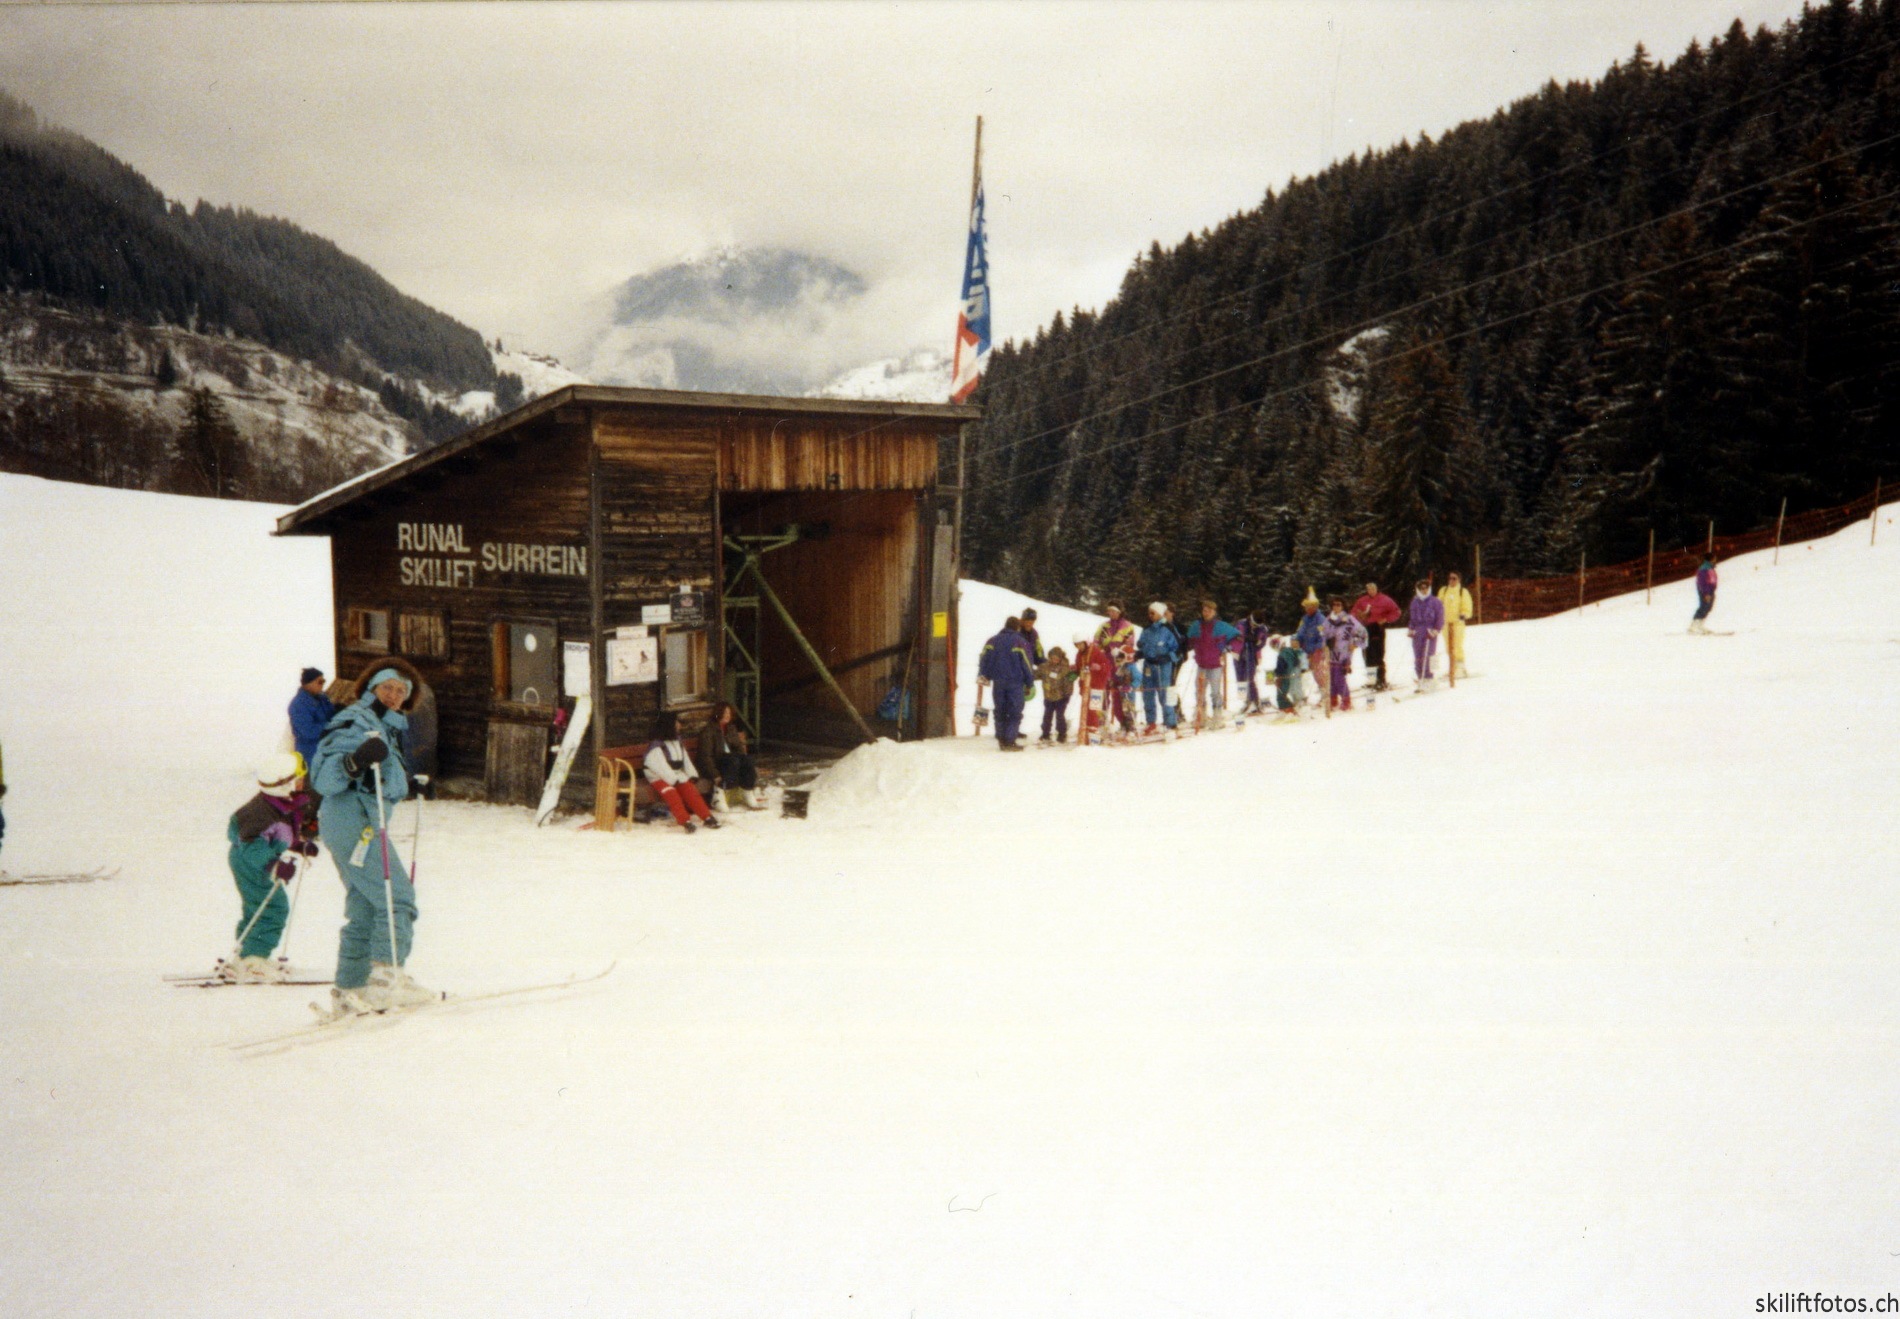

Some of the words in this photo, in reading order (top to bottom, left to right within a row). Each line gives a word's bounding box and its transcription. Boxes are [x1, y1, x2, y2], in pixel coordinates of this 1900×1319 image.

[398, 522, 471, 553] RUNAL
[400, 556, 477, 588] SKILIFT
[481, 542, 587, 576] SURREIN
